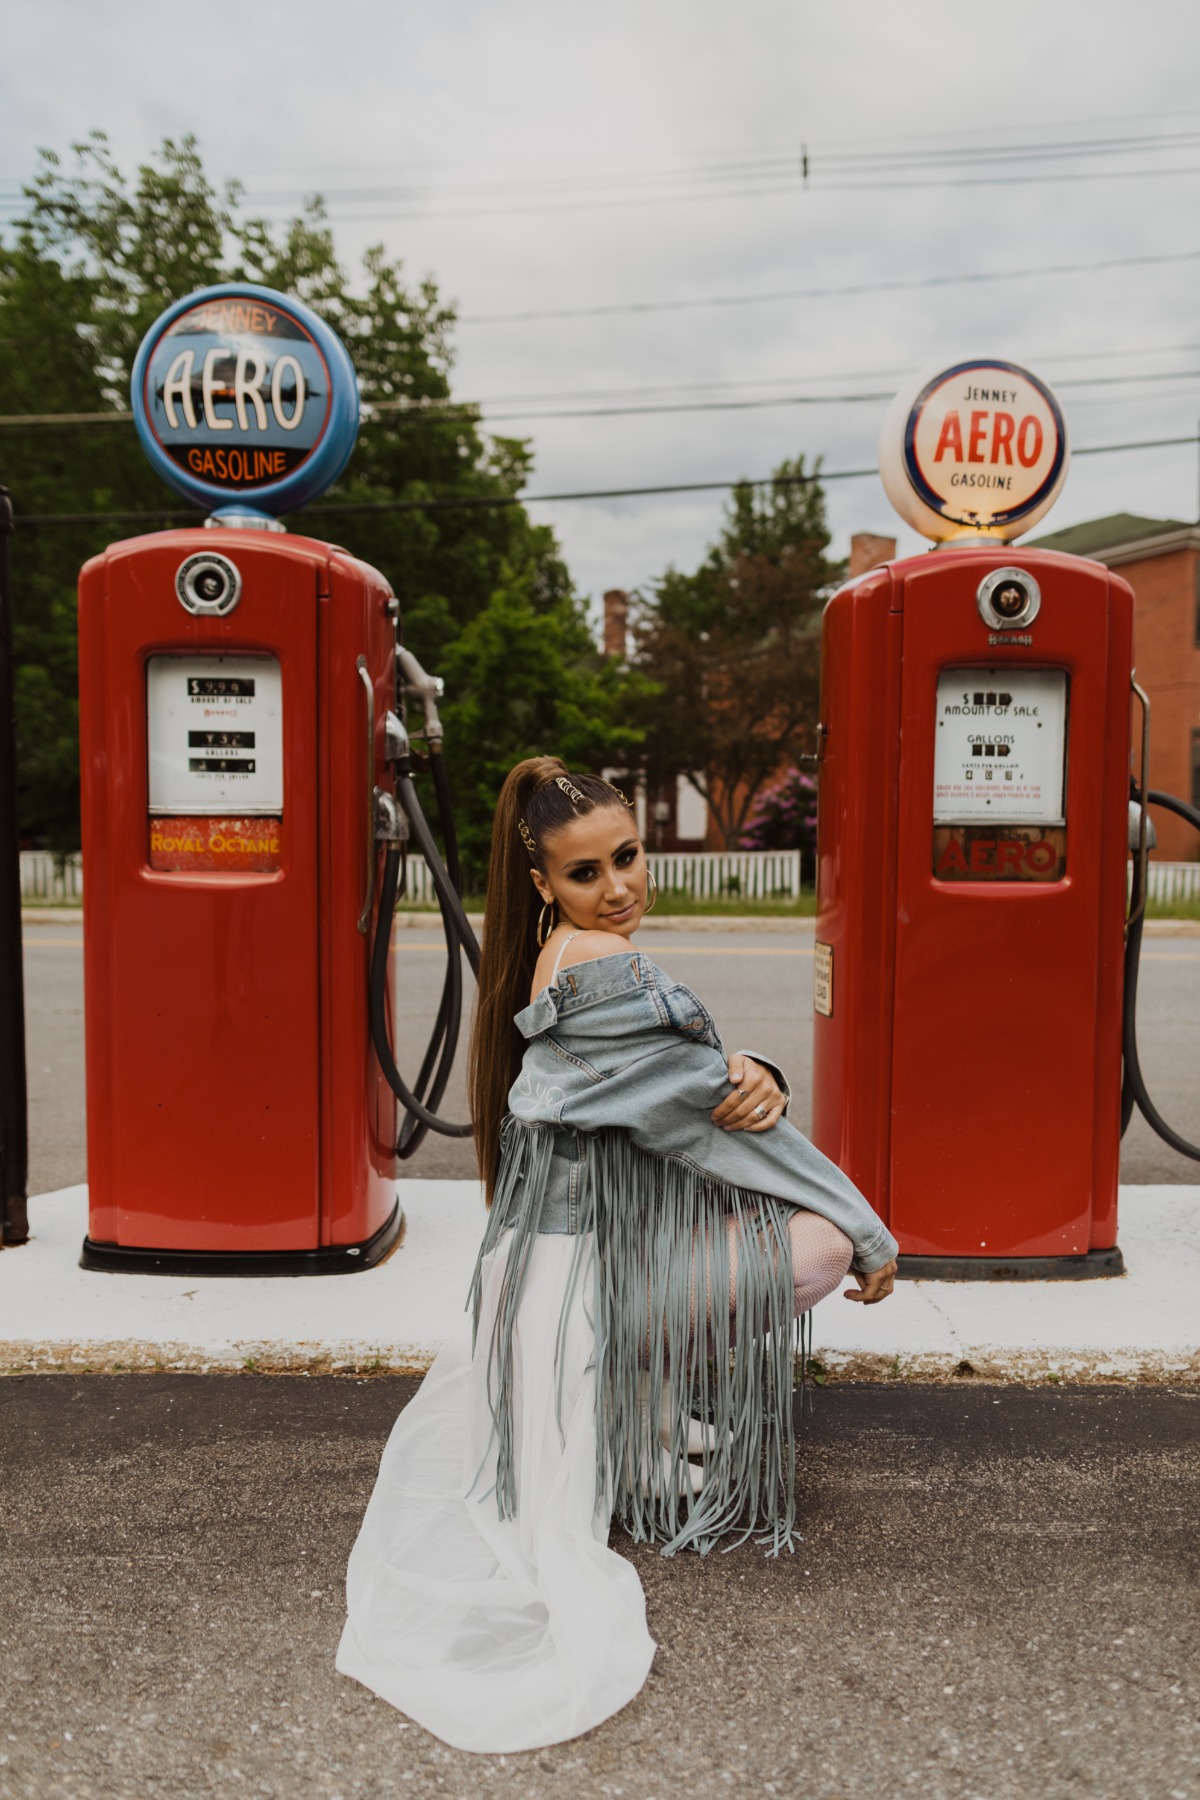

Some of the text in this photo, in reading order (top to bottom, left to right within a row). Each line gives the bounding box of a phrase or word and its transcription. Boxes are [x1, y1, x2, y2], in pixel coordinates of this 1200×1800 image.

[163, 348, 306, 431] AERO
[963, 385, 1018, 403] JENNEY
[933, 409, 1043, 468] AERO
[188, 449, 287, 481] GASOLINE
[950, 473, 1013, 490] GASOLINE
[945, 706, 1039, 716] AMOUNT OF SALE
[967, 735, 1015, 744] GALLONS
[151, 833, 280, 853] ROYAL OCTANE
[937, 839, 1057, 874] AERO
